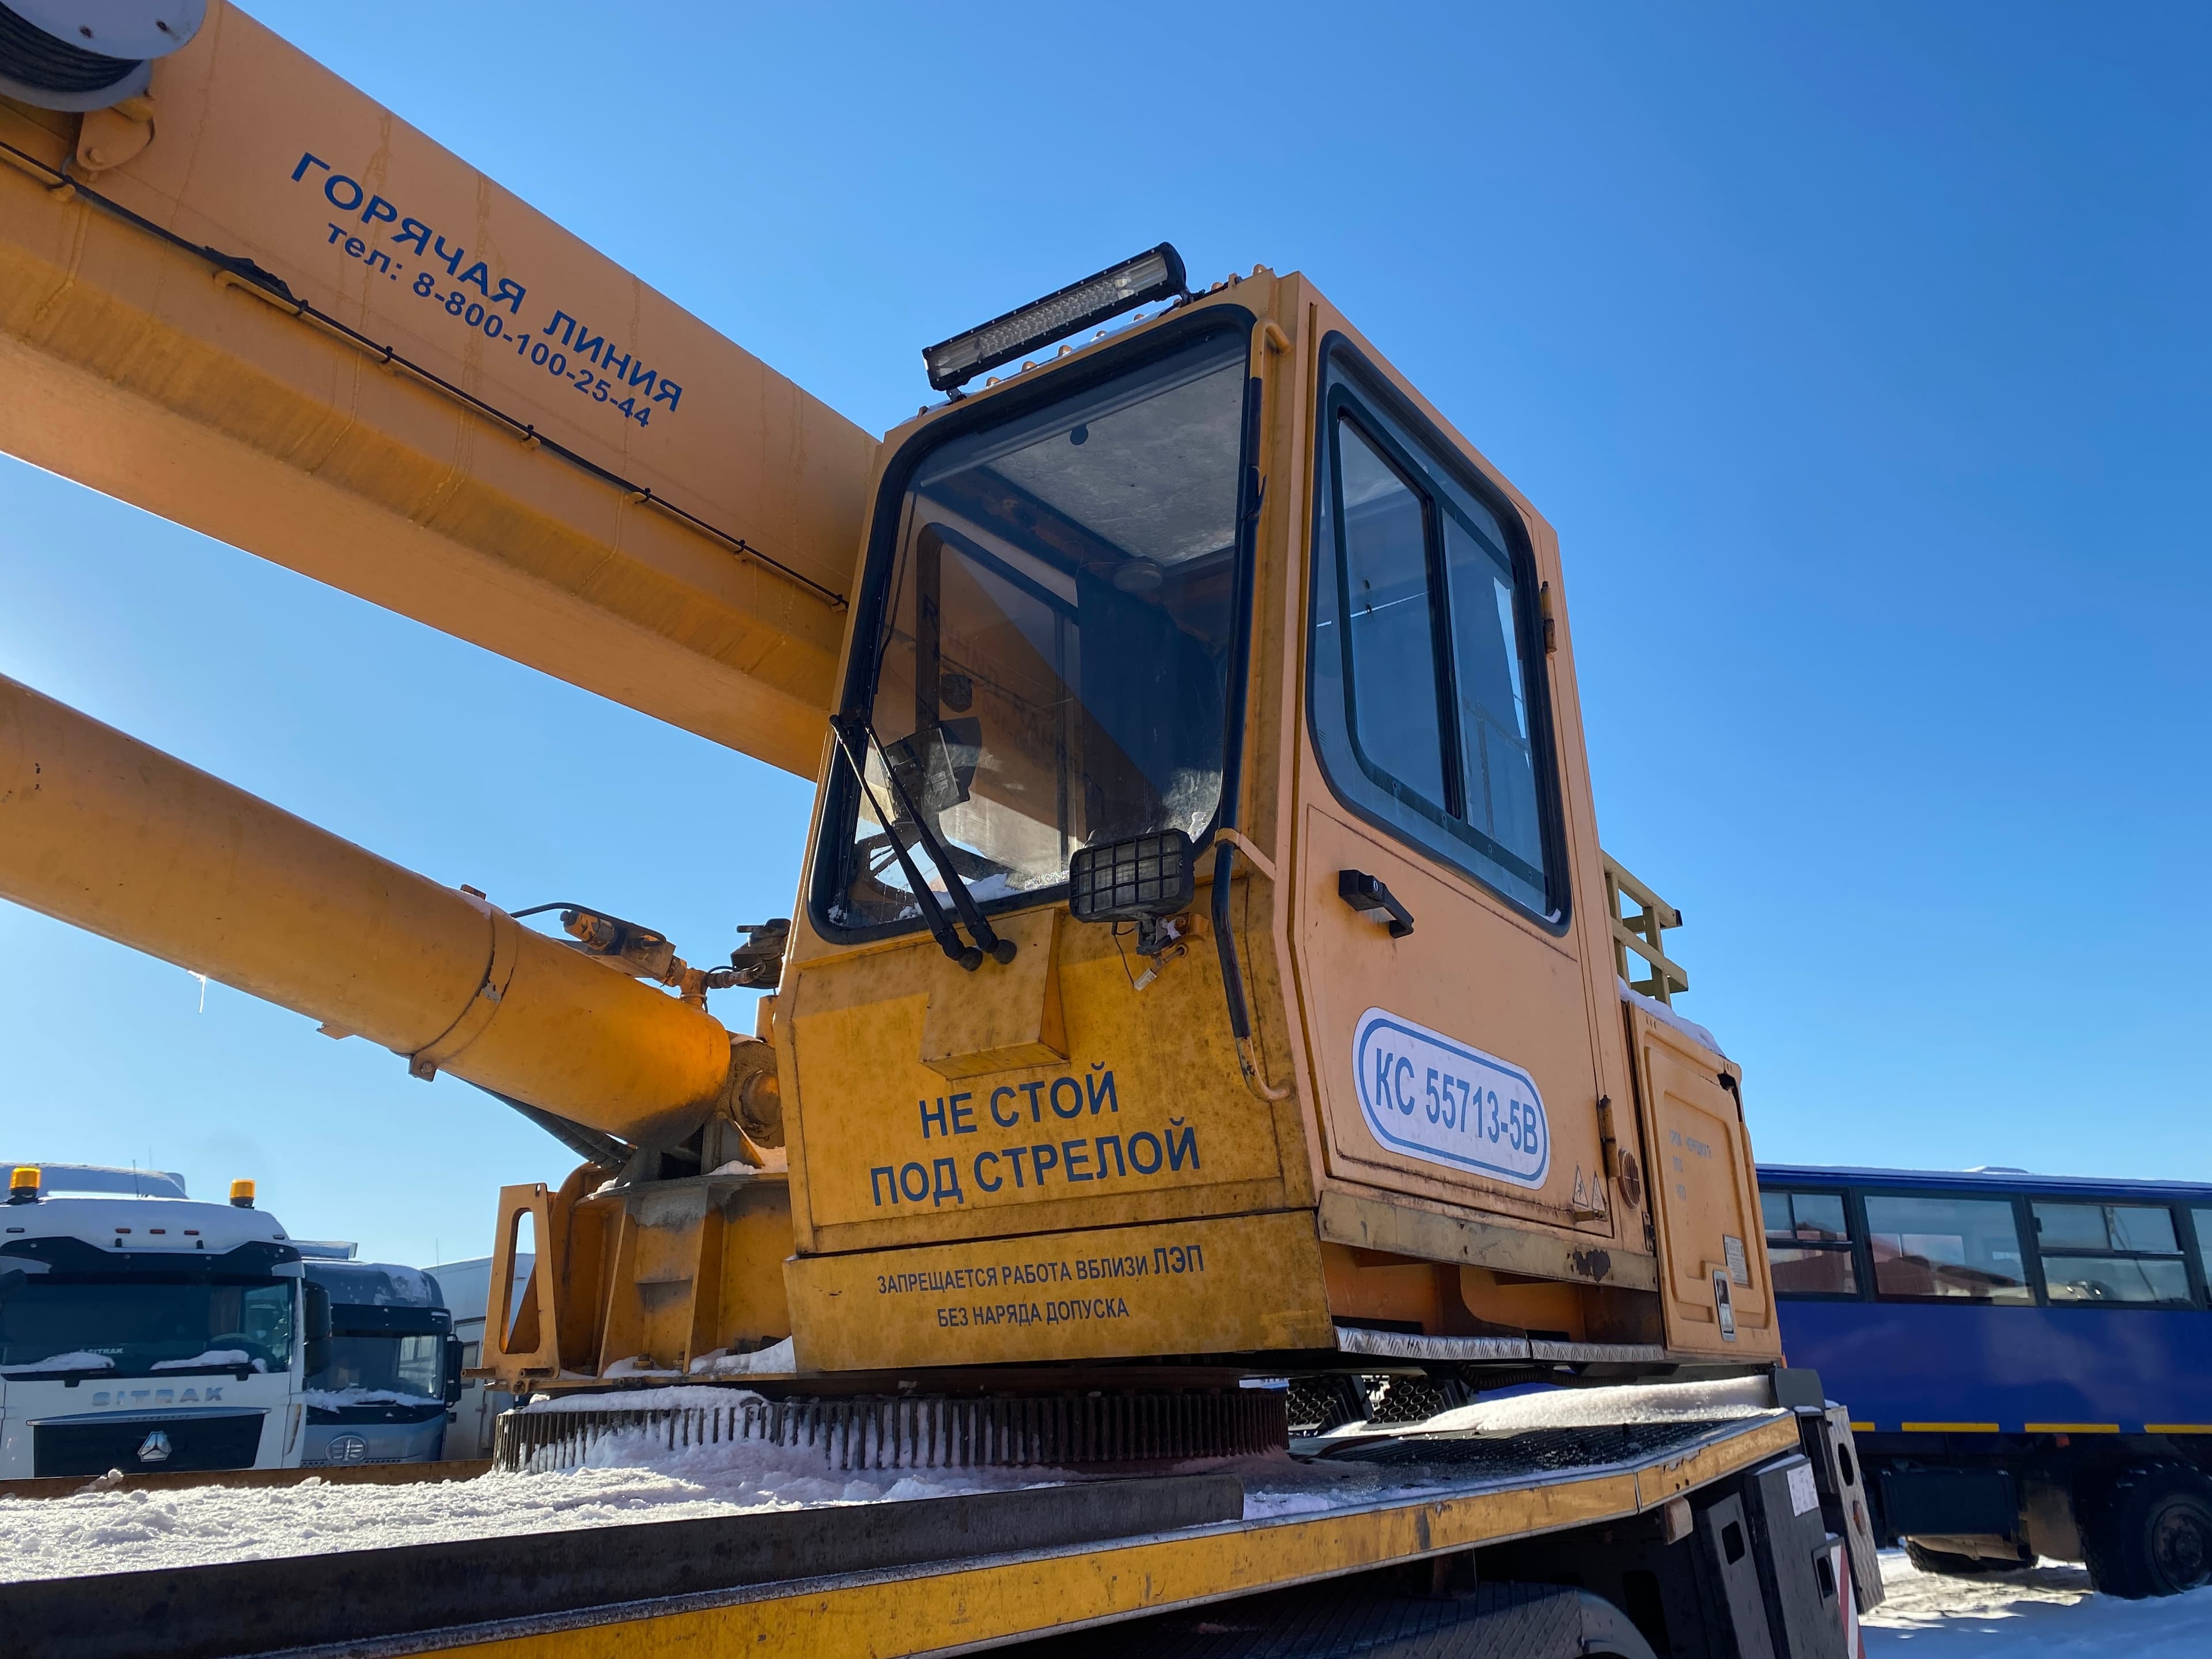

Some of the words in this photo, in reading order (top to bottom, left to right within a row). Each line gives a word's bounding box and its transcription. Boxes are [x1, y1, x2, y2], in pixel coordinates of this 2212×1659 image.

[291, 151, 527, 314] ГОРЯЧАЯ
[543, 310, 683, 412] ЛИНИЯ
[328, 222, 403, 281] тел:
[412, 271, 651, 427] 8-800-100-25-44
[919, 1092, 978, 1139] НЕ
[990, 1061, 1119, 1128] СТОЙ
[1375, 1047, 1415, 1115] КС
[1426, 1068, 1539, 1155] 55713-5В
[870, 1156, 964, 1207] ПОД
[974, 1116, 1201, 1193] СТРЕЛОЙ
[878, 1265, 998, 1294] ЗАПРЕЩАЕТСЯ
[1001, 1262, 1072, 1285] РАБОТА
[1075, 1252, 1149, 1281] ВБЛИЗИ
[1153, 1244, 1205, 1275] ЛЭП
[937, 1306, 969, 1328] БЕЗ
[972, 1302, 1043, 1327] НАРЯДА
[1046, 1296, 1130, 1325] ДОПУСКА
[92, 1387, 224, 1406] SITRAK
